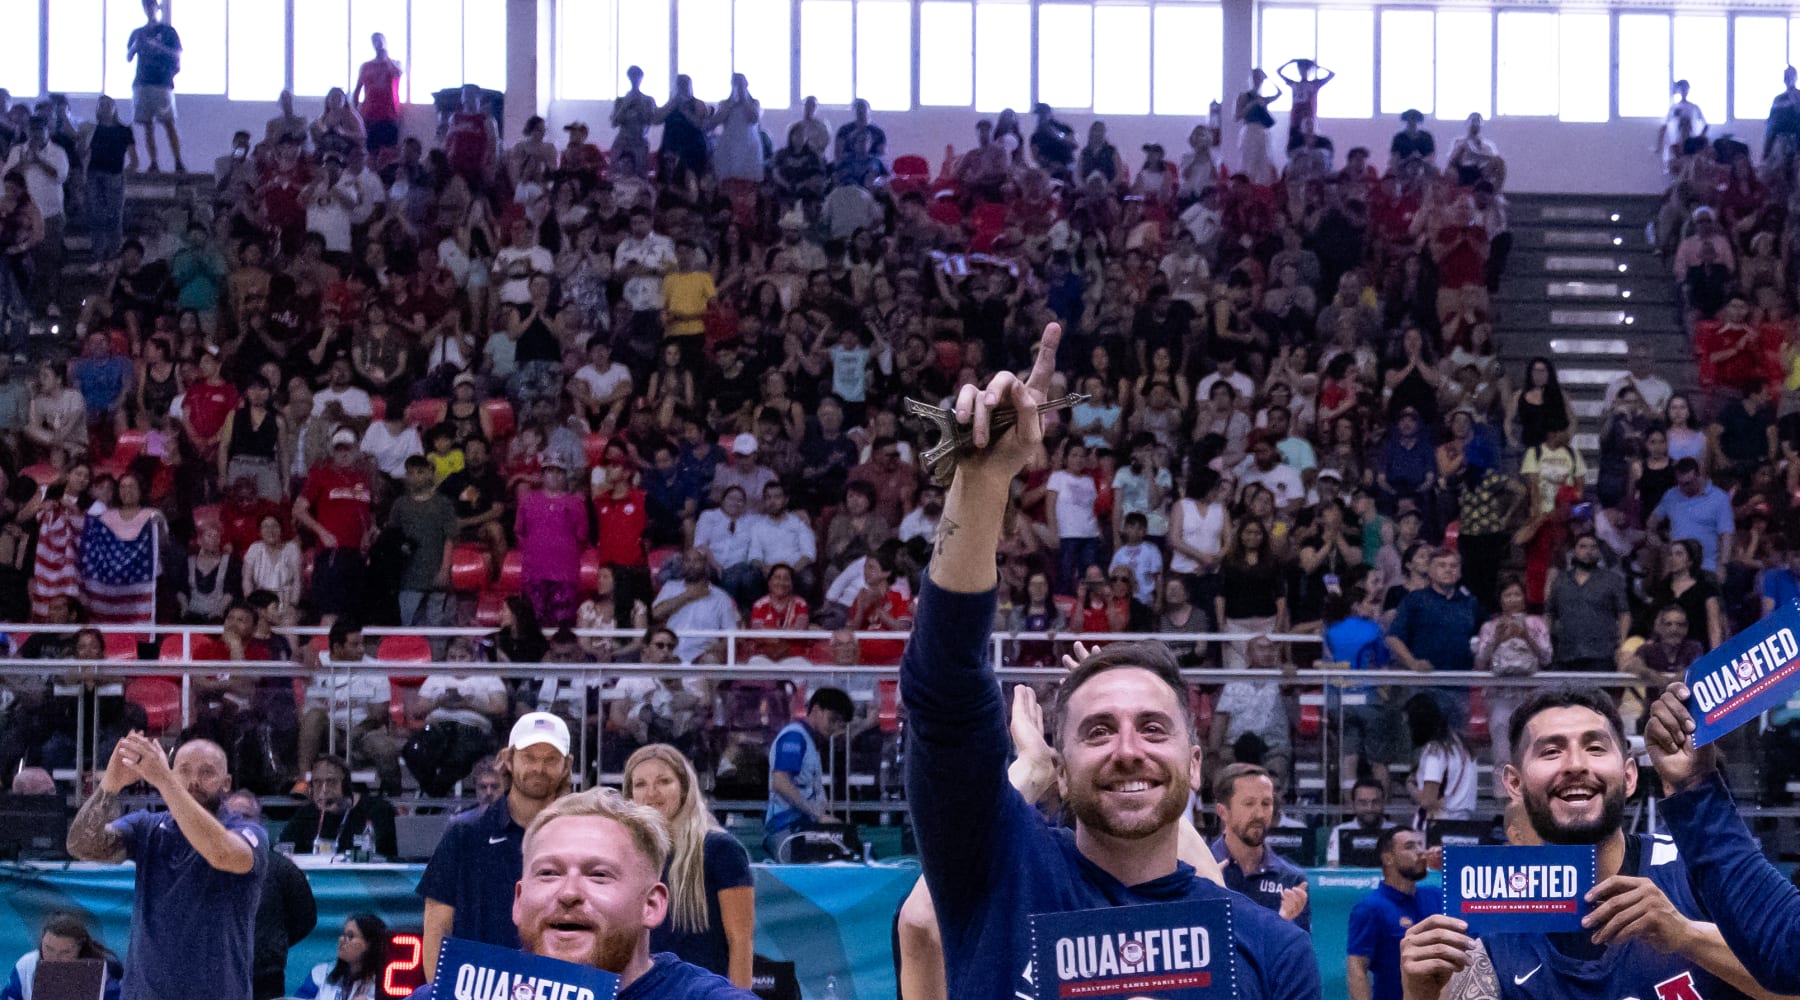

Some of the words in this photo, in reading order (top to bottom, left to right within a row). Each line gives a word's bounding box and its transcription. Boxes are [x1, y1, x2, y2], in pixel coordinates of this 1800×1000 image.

[1692, 627, 1799, 713] QUALIFIED
[1260, 880, 1284, 895] USA
[1460, 865, 1578, 899] QUALIFIED
[383, 935, 421, 996] 2
[1056, 926, 1211, 981] QUALIFIED
[1122, 981, 1150, 990] GAMES
